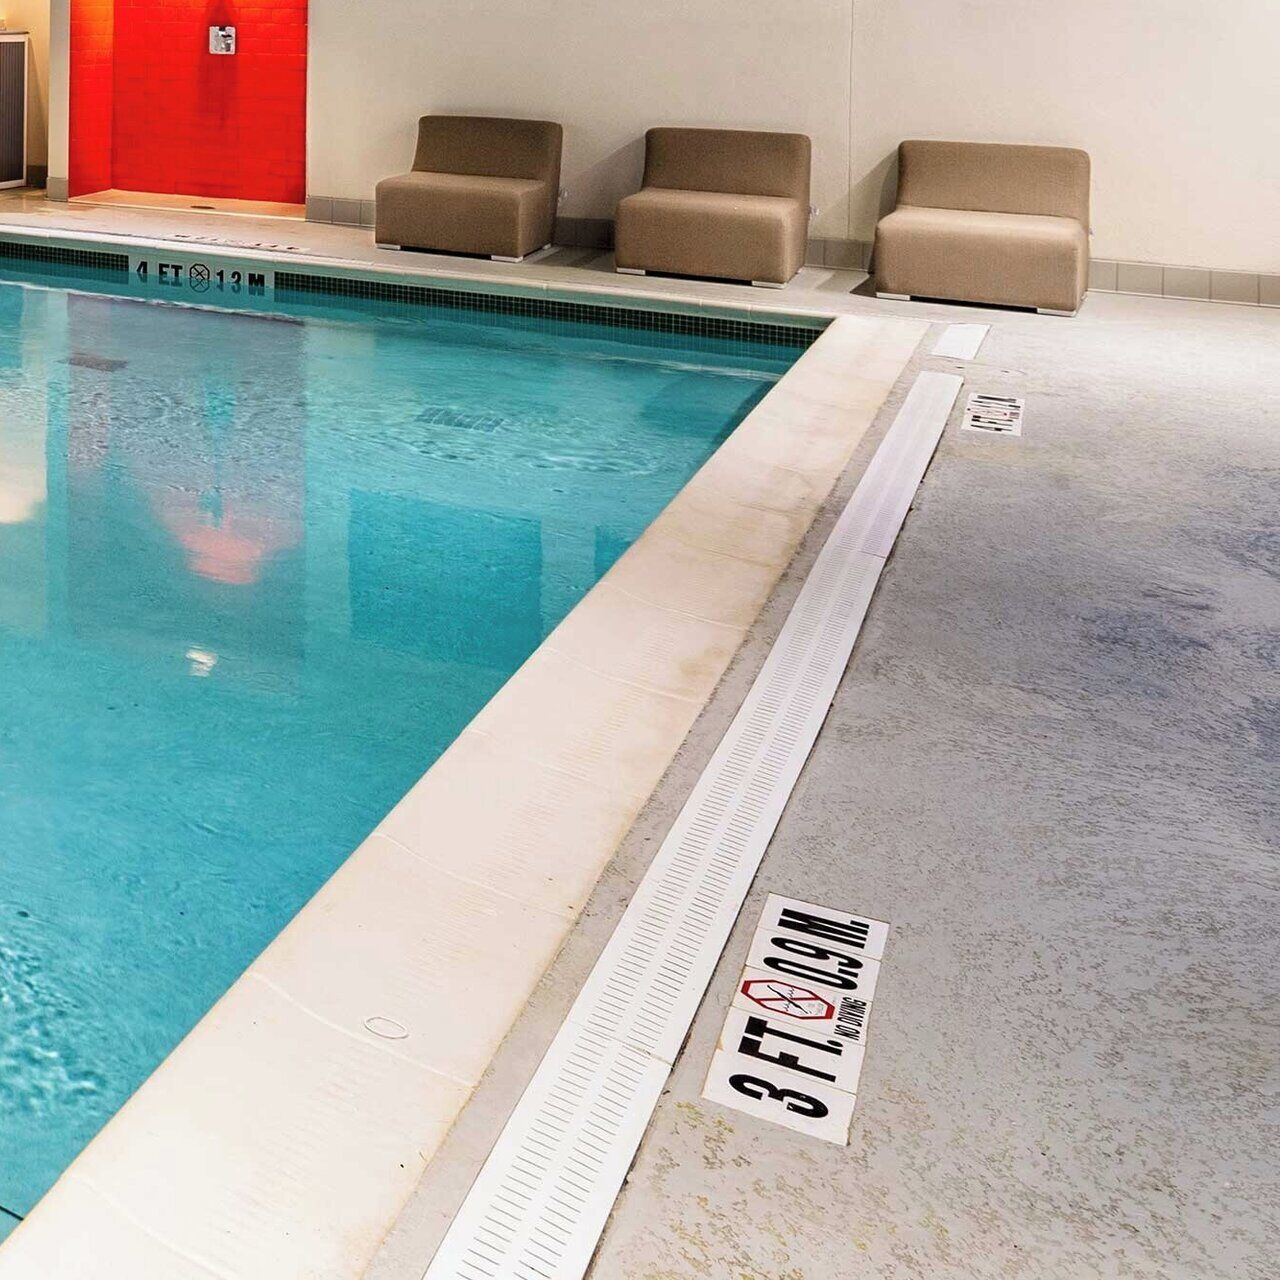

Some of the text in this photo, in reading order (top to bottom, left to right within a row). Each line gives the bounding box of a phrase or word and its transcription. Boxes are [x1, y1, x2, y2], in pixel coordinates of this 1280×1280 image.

[728, 908, 870, 1118] 3 FT. 0.9 M.
[834, 996, 867, 1041] NO DIVING
